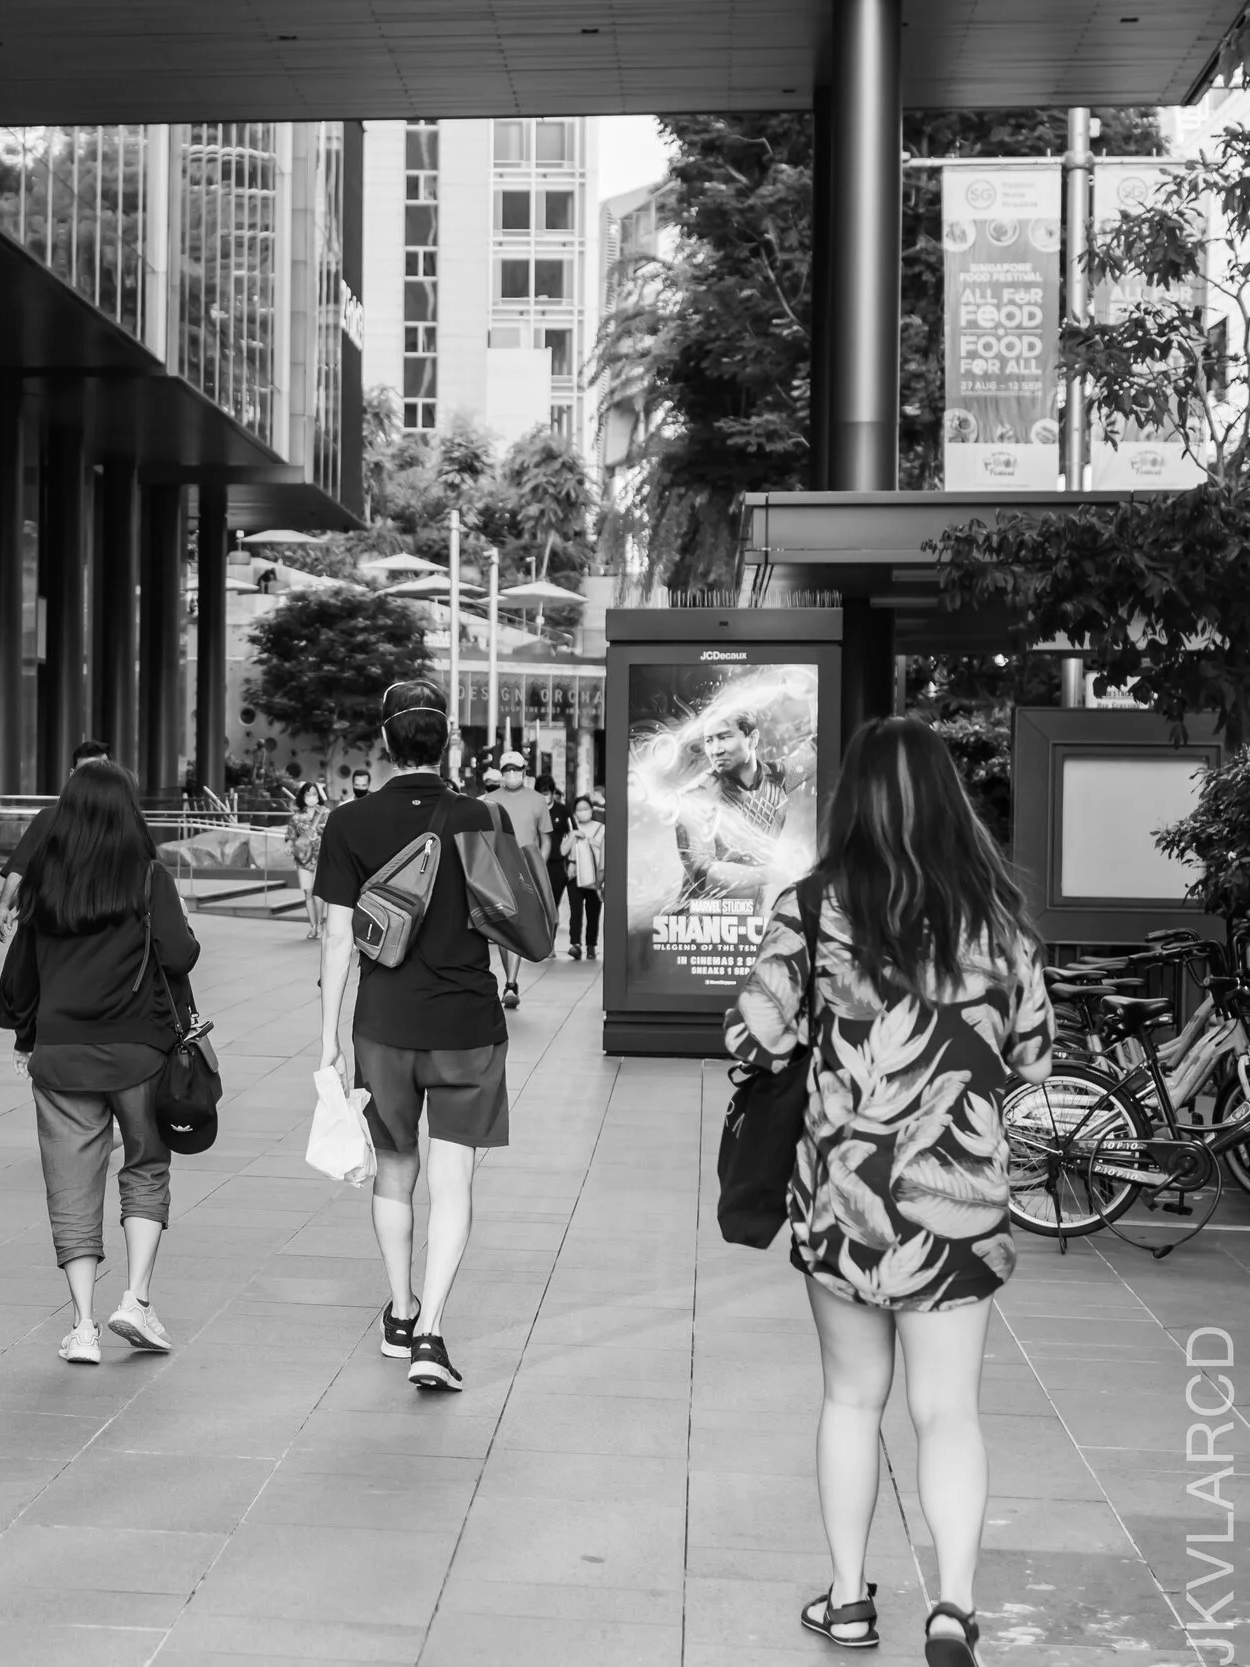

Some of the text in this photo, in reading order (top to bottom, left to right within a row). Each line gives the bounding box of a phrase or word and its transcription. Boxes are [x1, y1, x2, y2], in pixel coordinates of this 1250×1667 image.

[960, 271, 1043, 281] FOOD FESTIVAL
[961, 287, 1043, 304] ALL FOR
[960, 304, 1043, 328] FOOD
[960, 334, 1043, 357] FOOD
[960, 358, 1043, 375] FOR ALL
[700, 650, 748, 661] JCDecaux
[458, 685, 524, 701] DESGN
[691, 899, 754, 914] MARVEL STUDIOS
[653, 915, 769, 944] SHANG-C
[739, 944, 757, 952] TEN
[677, 956, 687, 965] IN
[690, 956, 734, 966] CINEMAS
[737, 957, 744, 966] 2
[691, 966, 750, 975] SNEAKS 1 SEP
